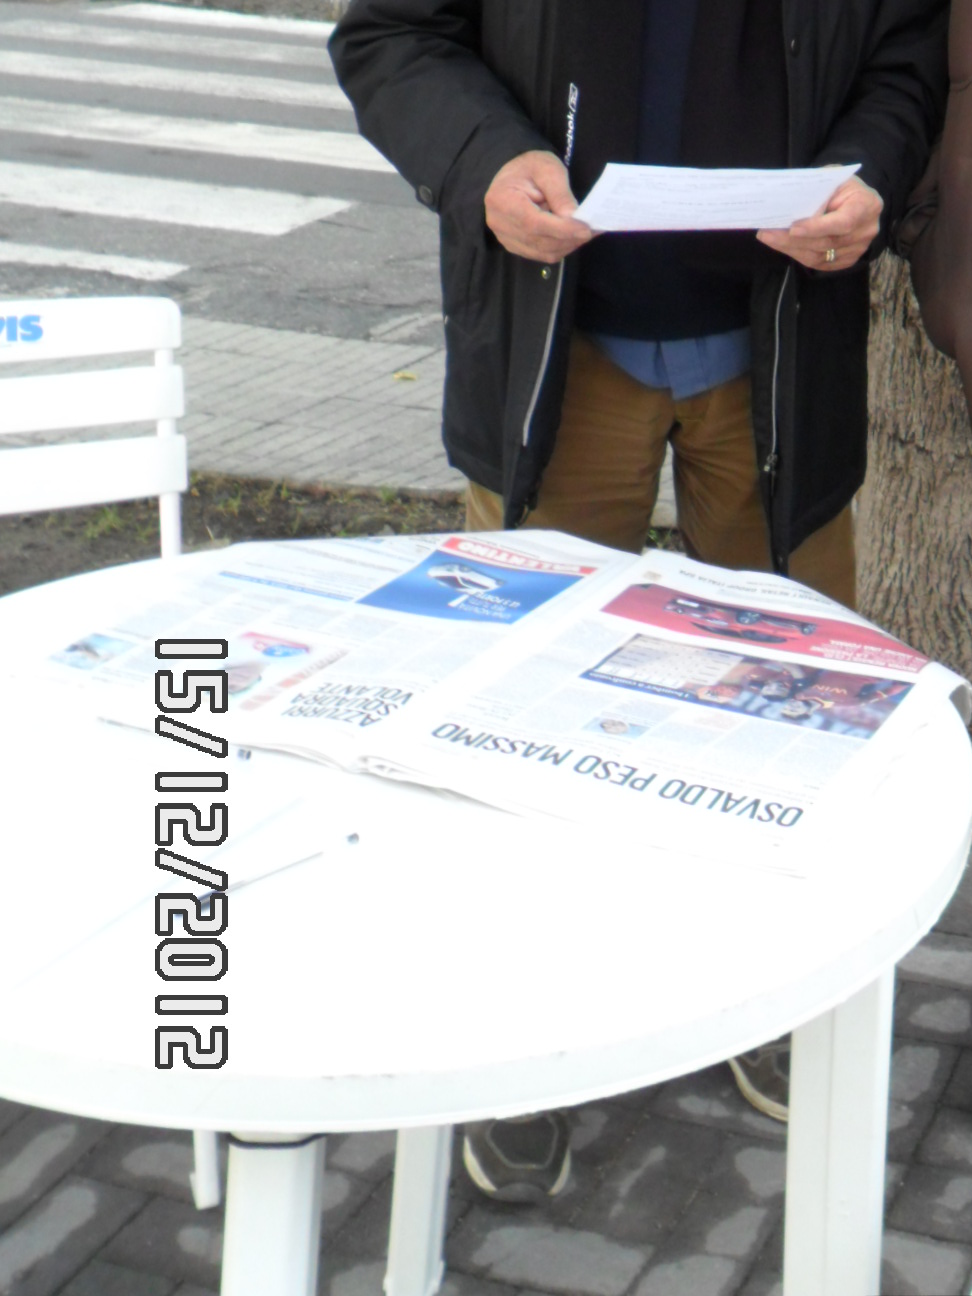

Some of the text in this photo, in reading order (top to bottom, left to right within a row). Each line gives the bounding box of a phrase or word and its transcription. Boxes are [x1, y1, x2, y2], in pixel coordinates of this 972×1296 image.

[0, 315, 43, 342] IS
[290, 693, 398, 717] SQUADRA
[318, 682, 413, 705] VOLANTE
[281, 704, 382, 727] AZZURRI
[431, 722, 574, 766] MASSIMO
[572, 754, 656, 792] PESO
[658, 778, 804, 828] OSVALDO
